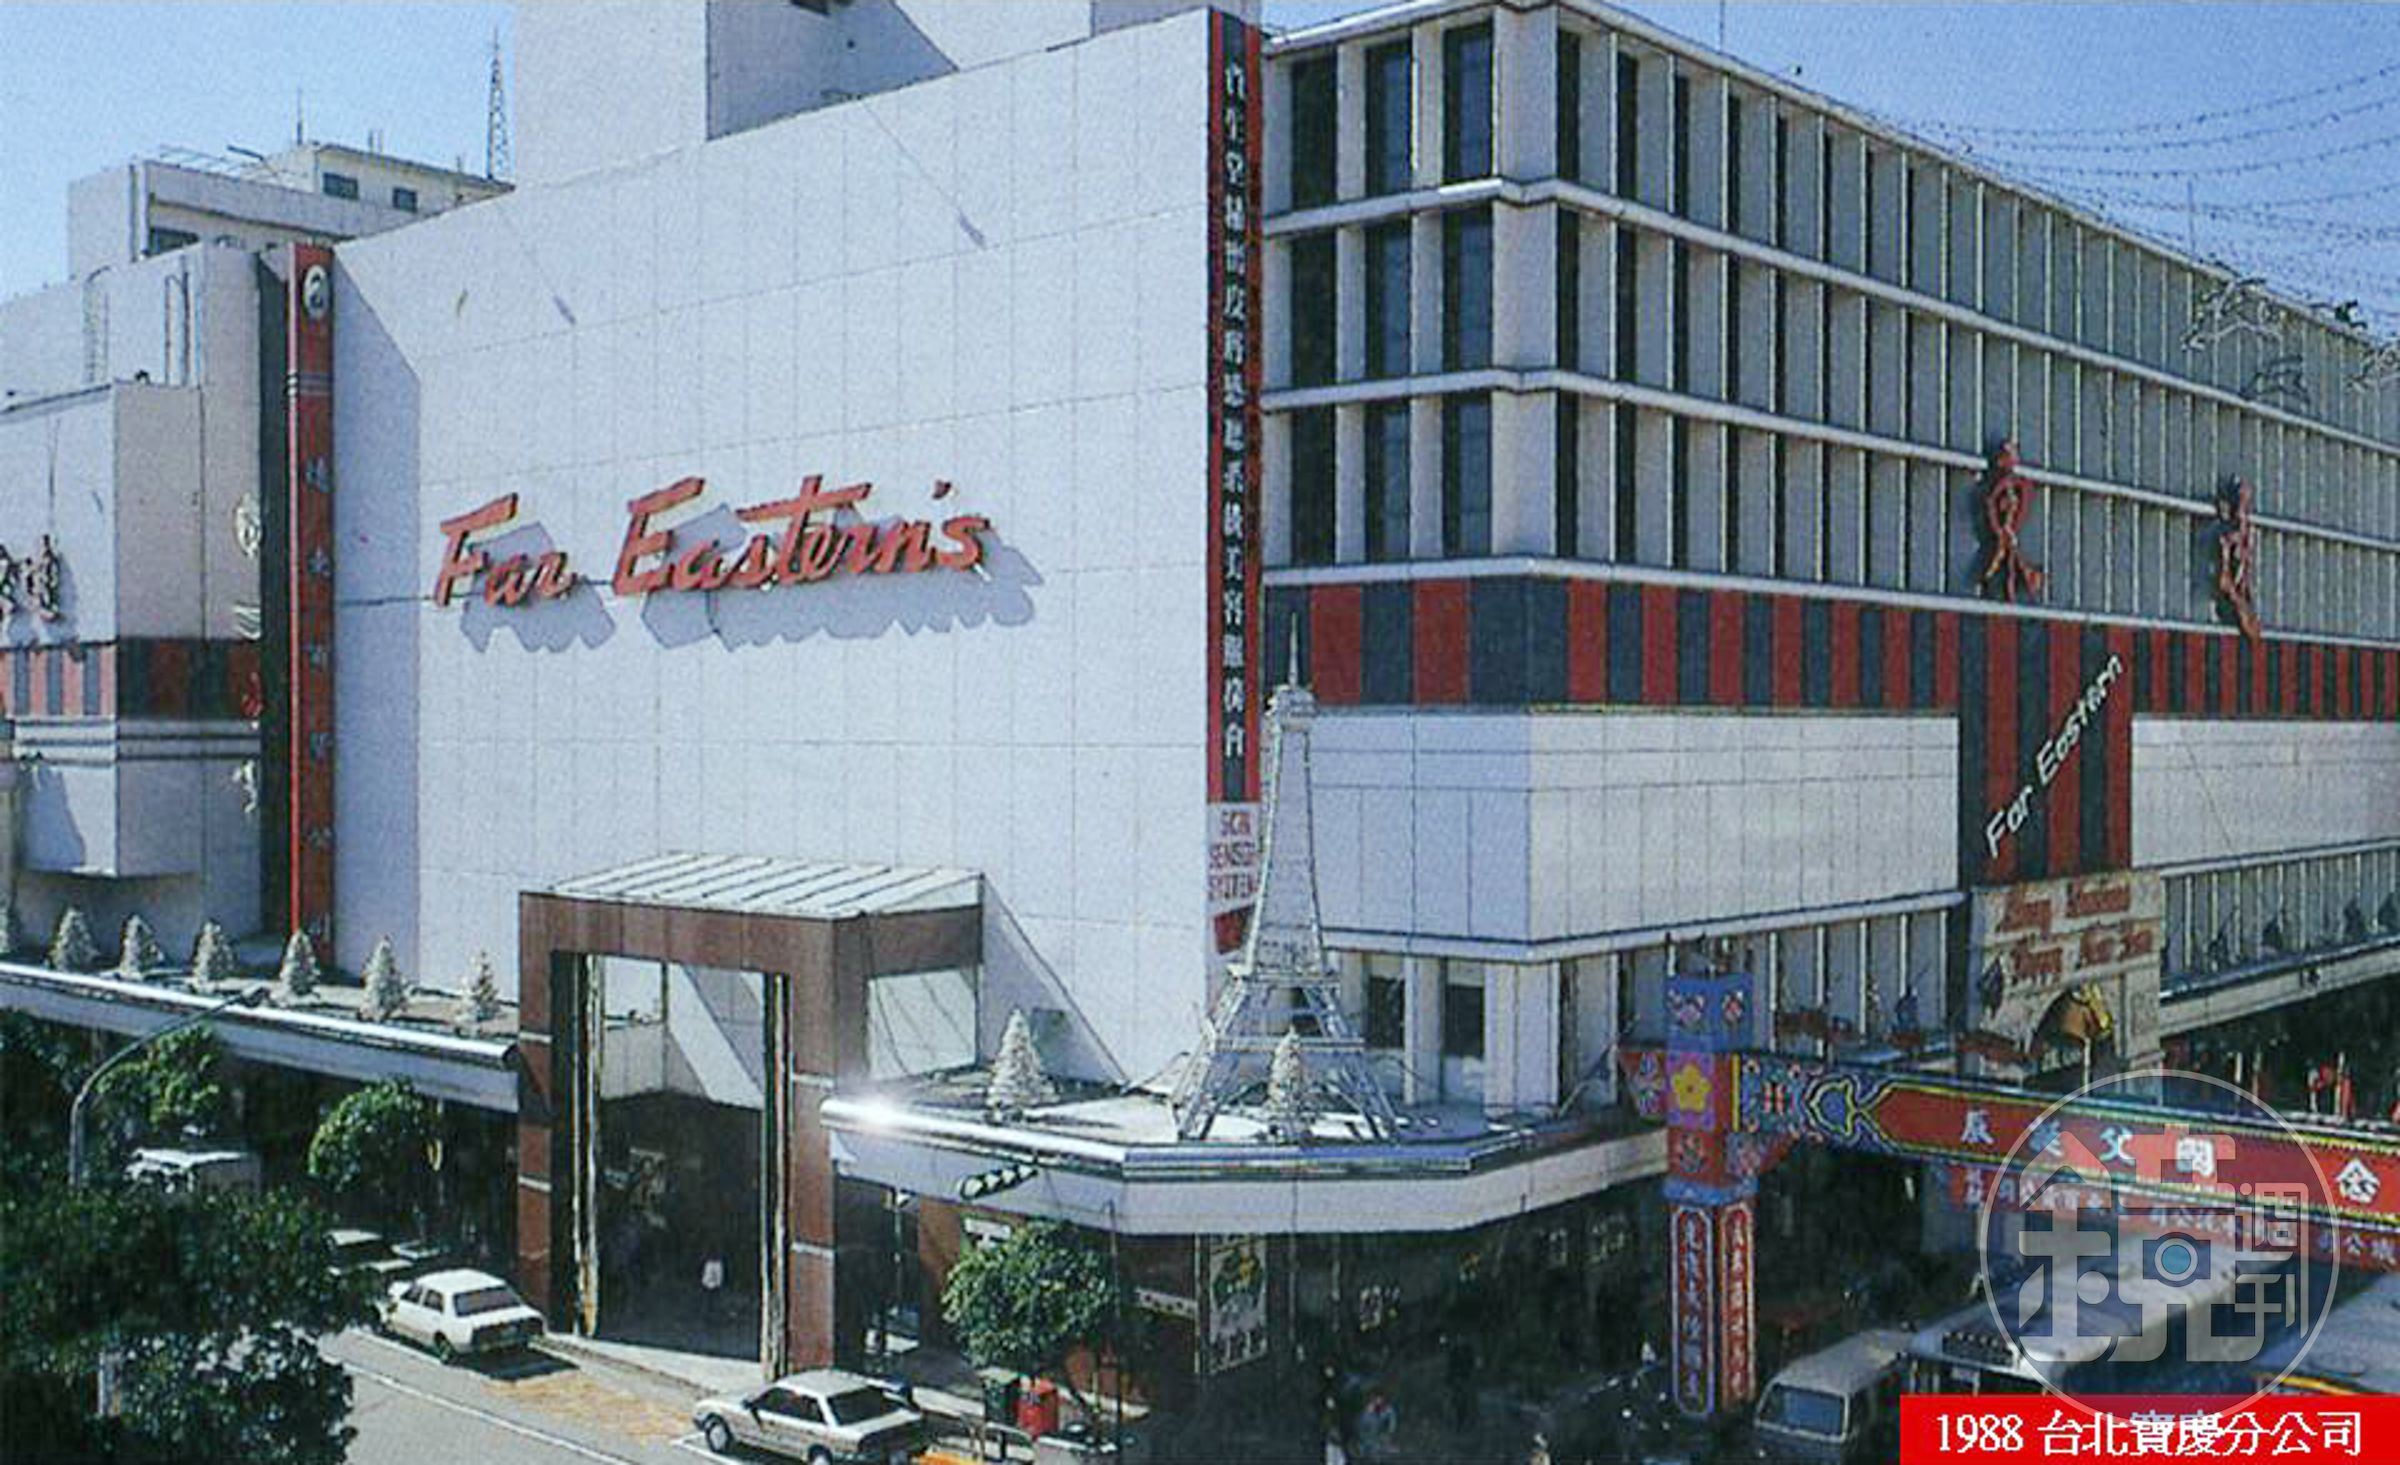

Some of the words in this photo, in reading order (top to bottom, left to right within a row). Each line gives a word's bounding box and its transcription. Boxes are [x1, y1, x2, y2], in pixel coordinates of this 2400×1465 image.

[431, 492, 579, 608] Far
[612, 474, 991, 598] Eastern's
[1986, 784, 2034, 858] Far
[2036, 654, 2124, 786] Eastern
